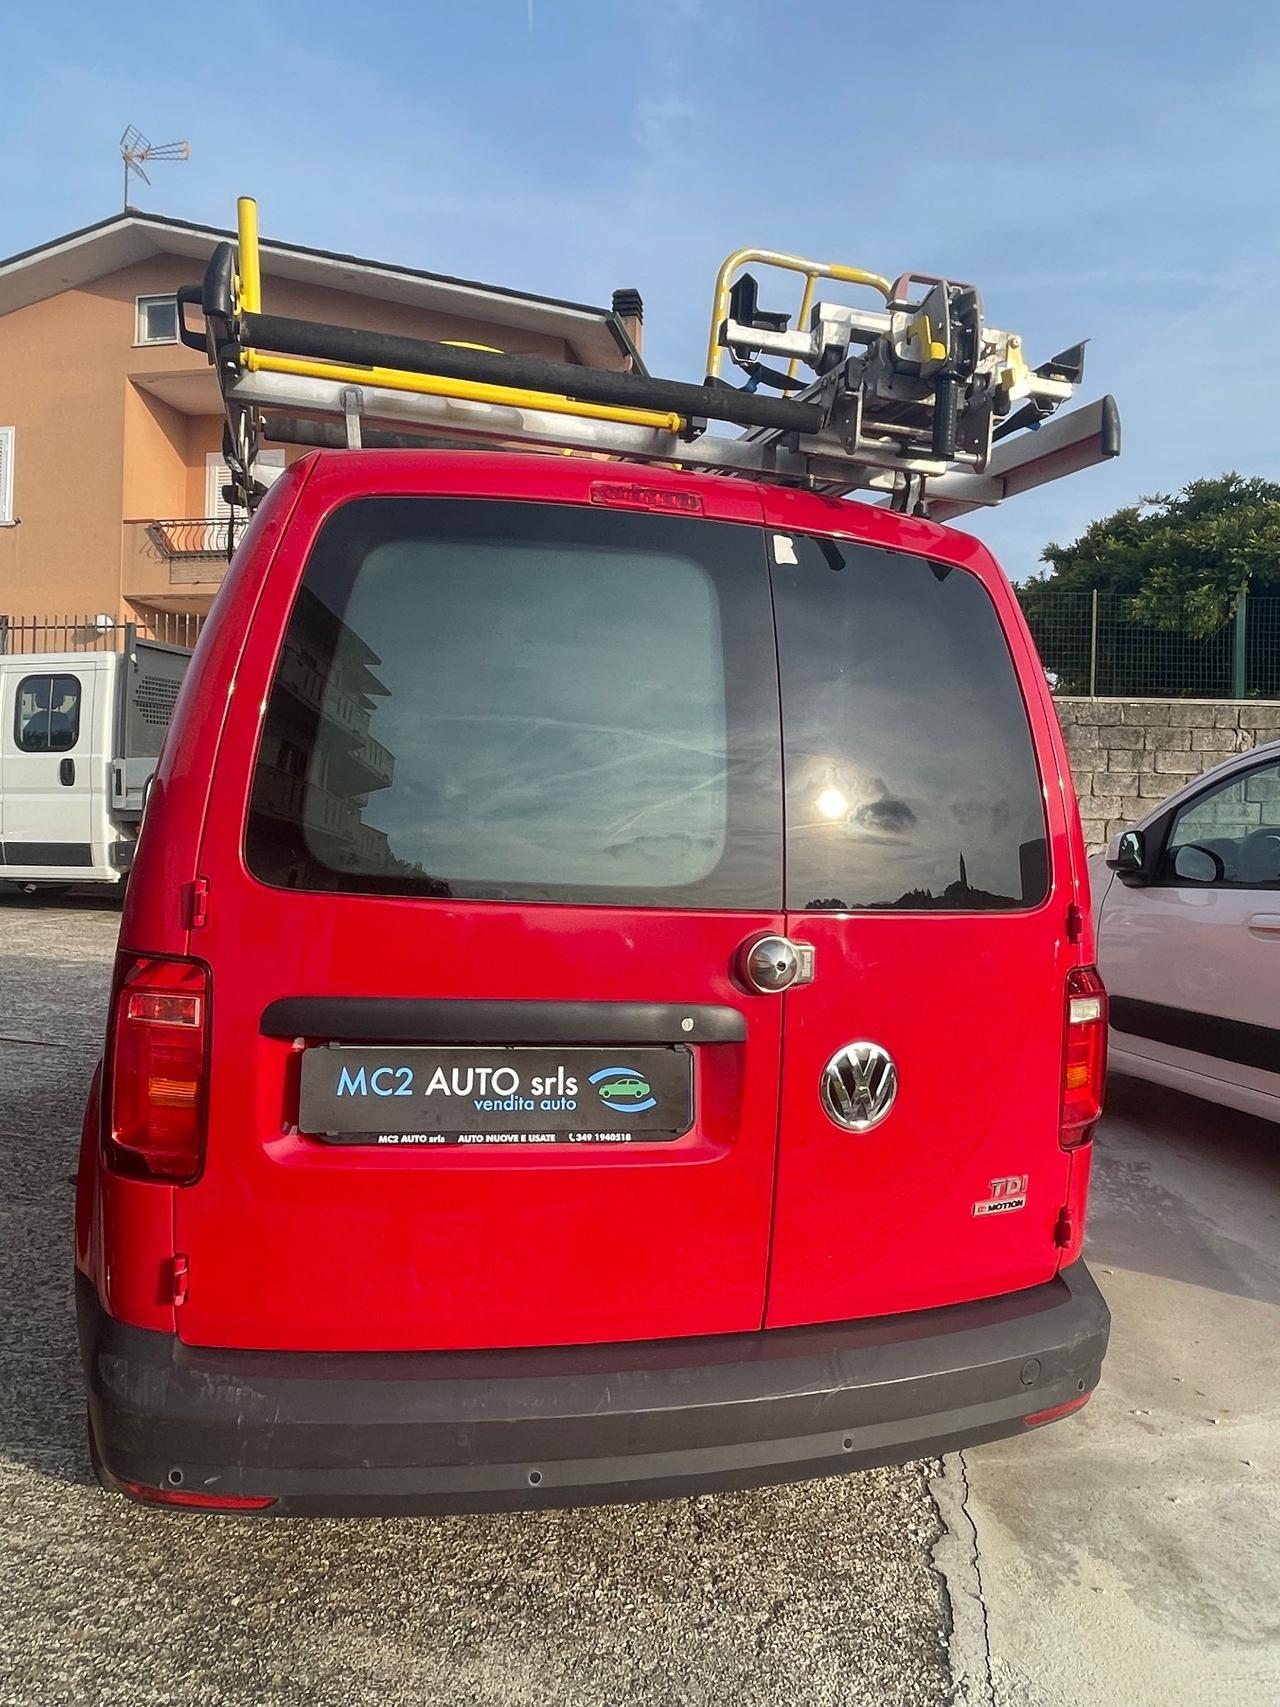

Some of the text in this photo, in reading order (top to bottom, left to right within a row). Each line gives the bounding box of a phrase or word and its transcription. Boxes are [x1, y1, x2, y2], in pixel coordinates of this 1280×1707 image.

[336, 1065, 579, 1096] MC2 AUTO srls
[473, 1094, 577, 1111] vendita auto
[377, 1133, 632, 1144] MC2 AUTO srls AUTO NUOVE E USATE 349 1940518
[989, 1175, 1028, 1199] TDI
